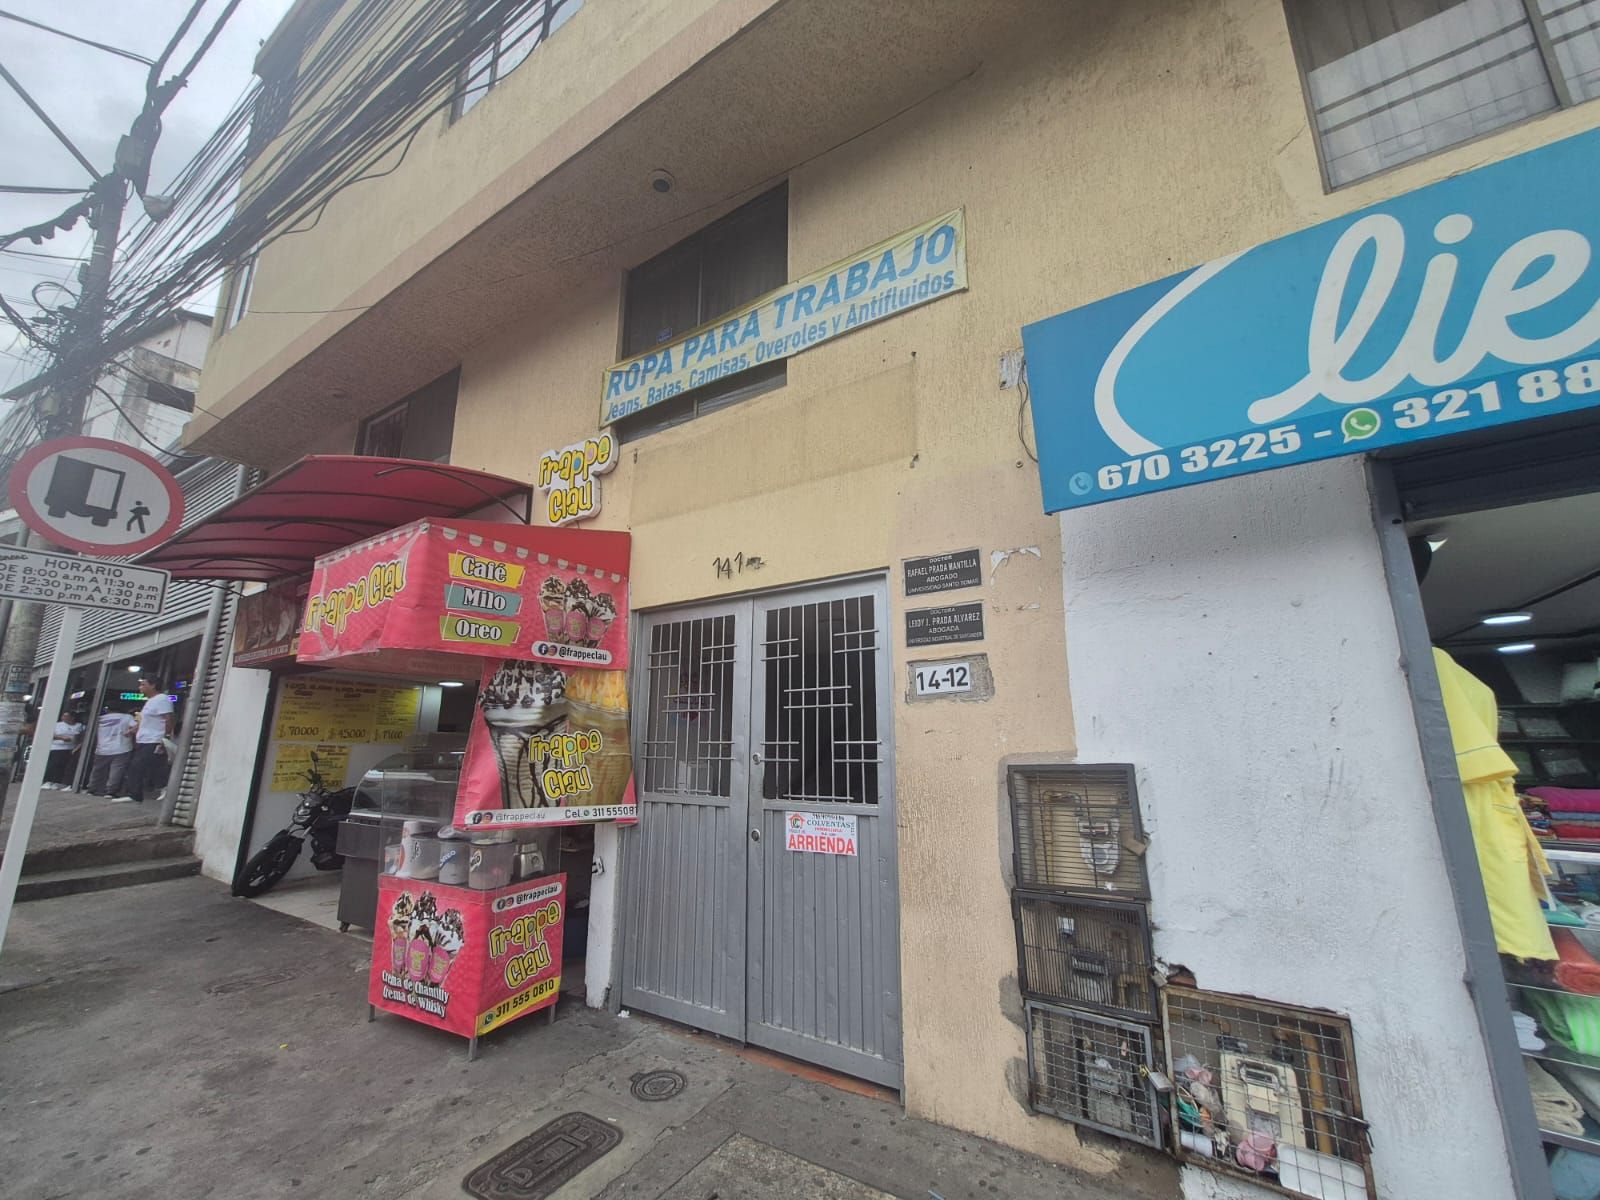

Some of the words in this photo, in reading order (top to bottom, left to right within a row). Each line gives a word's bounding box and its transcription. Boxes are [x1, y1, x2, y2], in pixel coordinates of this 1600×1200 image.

[606, 348, 673, 400] ROPA
[681, 310, 760, 369] PARA
[774, 224, 955, 329] TRABAJO
[755, 319, 827, 363] Overoles
[832, 316, 841, 337] y
[845, 270, 955, 329] Antifluidos
[1097, 454, 1170, 491] 670
[1180, 426, 1302, 472] 3225
[1393, 380, 1502, 430] 321
[1517, 359, 1600, 404] 88
[538, 435, 611, 488] Frappe
[549, 481, 592, 522] Clau
[23, 567, 58, 578] 8:00
[89, 576, 99, 584] A
[104, 578, 135, 588] 11:30
[45, 558, 123, 577] HORARIO
[462, 555, 507, 582] Café
[926, 572, 958, 583] ABOGADO
[929, 563, 947, 574] PRADA
[19, 586, 54, 597] 2:30
[100, 596, 130, 606] 6:30
[22, 576, 60, 587] 12:30
[107, 588, 133, 597] 1:30
[463, 587, 506, 612] Milo
[928, 625, 960, 634] ABOGADA
[932, 615, 951, 626] PRADA
[953, 612, 980, 623] ALVAREZ
[455, 620, 502, 641] Oreo
[559, 646, 607, 660] @frappeclau
[916, 667, 968, 691] 14-12
[529, 731, 601, 766] Frappe
[544, 767, 592, 798] Clau
[807, 819, 851, 828] COLVENTAS
[788, 834, 855, 854] ARRIENDA
[516, 885, 557, 904] @frappeclau
[489, 901, 560, 957] Frappe
[505, 943, 551, 988] Clau
[382, 970, 402, 987] Crema
[404, 980, 413, 991] de
[383, 985, 405, 1002] Crema
[407, 994, 416, 1006] de
[418, 997, 446, 1017] Whisky
[496, 1001, 509, 1017] 311
[513, 991, 530, 1008] 555
[532, 979, 554, 997] 0810
